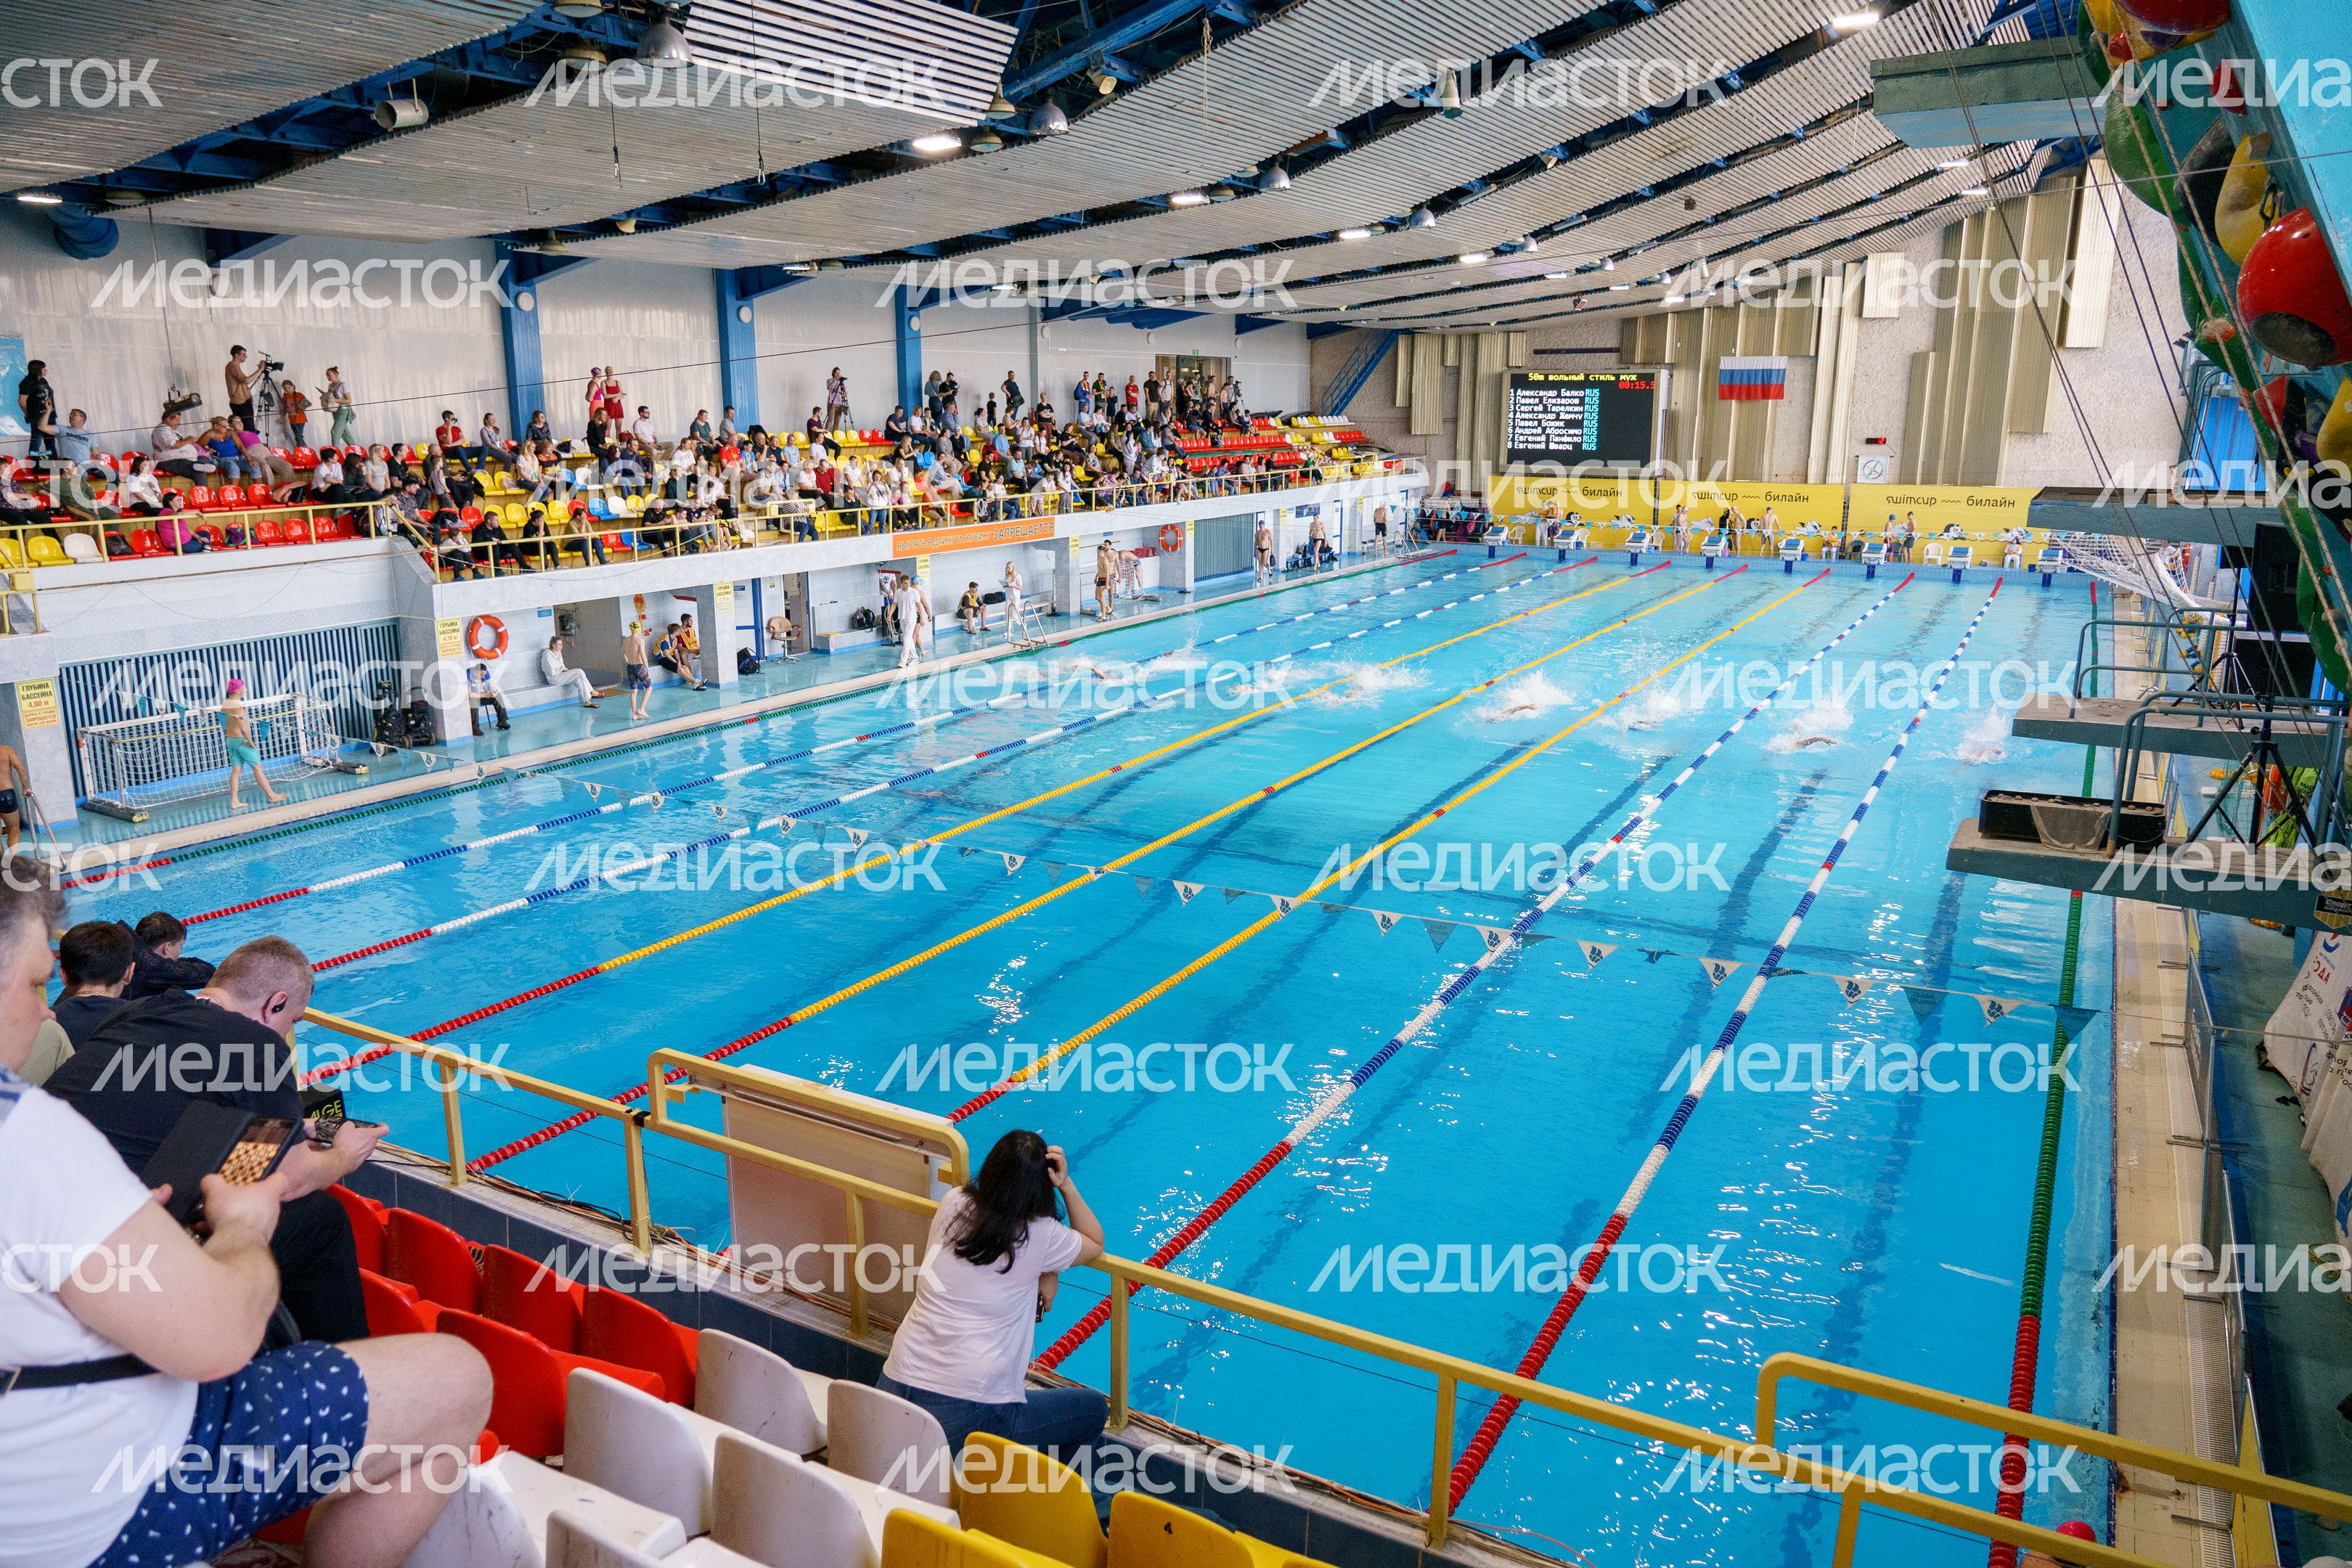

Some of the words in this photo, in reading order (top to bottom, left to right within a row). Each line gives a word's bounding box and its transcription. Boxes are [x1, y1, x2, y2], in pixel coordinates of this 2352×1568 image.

[1516, 486, 1558, 497] swimcup
[1582, 486, 1622, 498] билайн
[1692, 491, 1738, 502] swimcup
[1765, 491, 1809, 502] билайн
[1886, 494, 1937, 507] swimcup
[1967, 495, 2015, 507] билайн
[897, 539, 926, 551] НЫРЯТЬ
[933, 536, 956, 547] ДЛИНУ
[962, 531, 991, 542] ГЛУБИНУ
[993, 523, 1053, 540] ЗАПРЕЩАЕТСЯ
[23, 683, 49, 692] ГЛУБИНА
[22, 691, 52, 700] БАССЕЙНА
